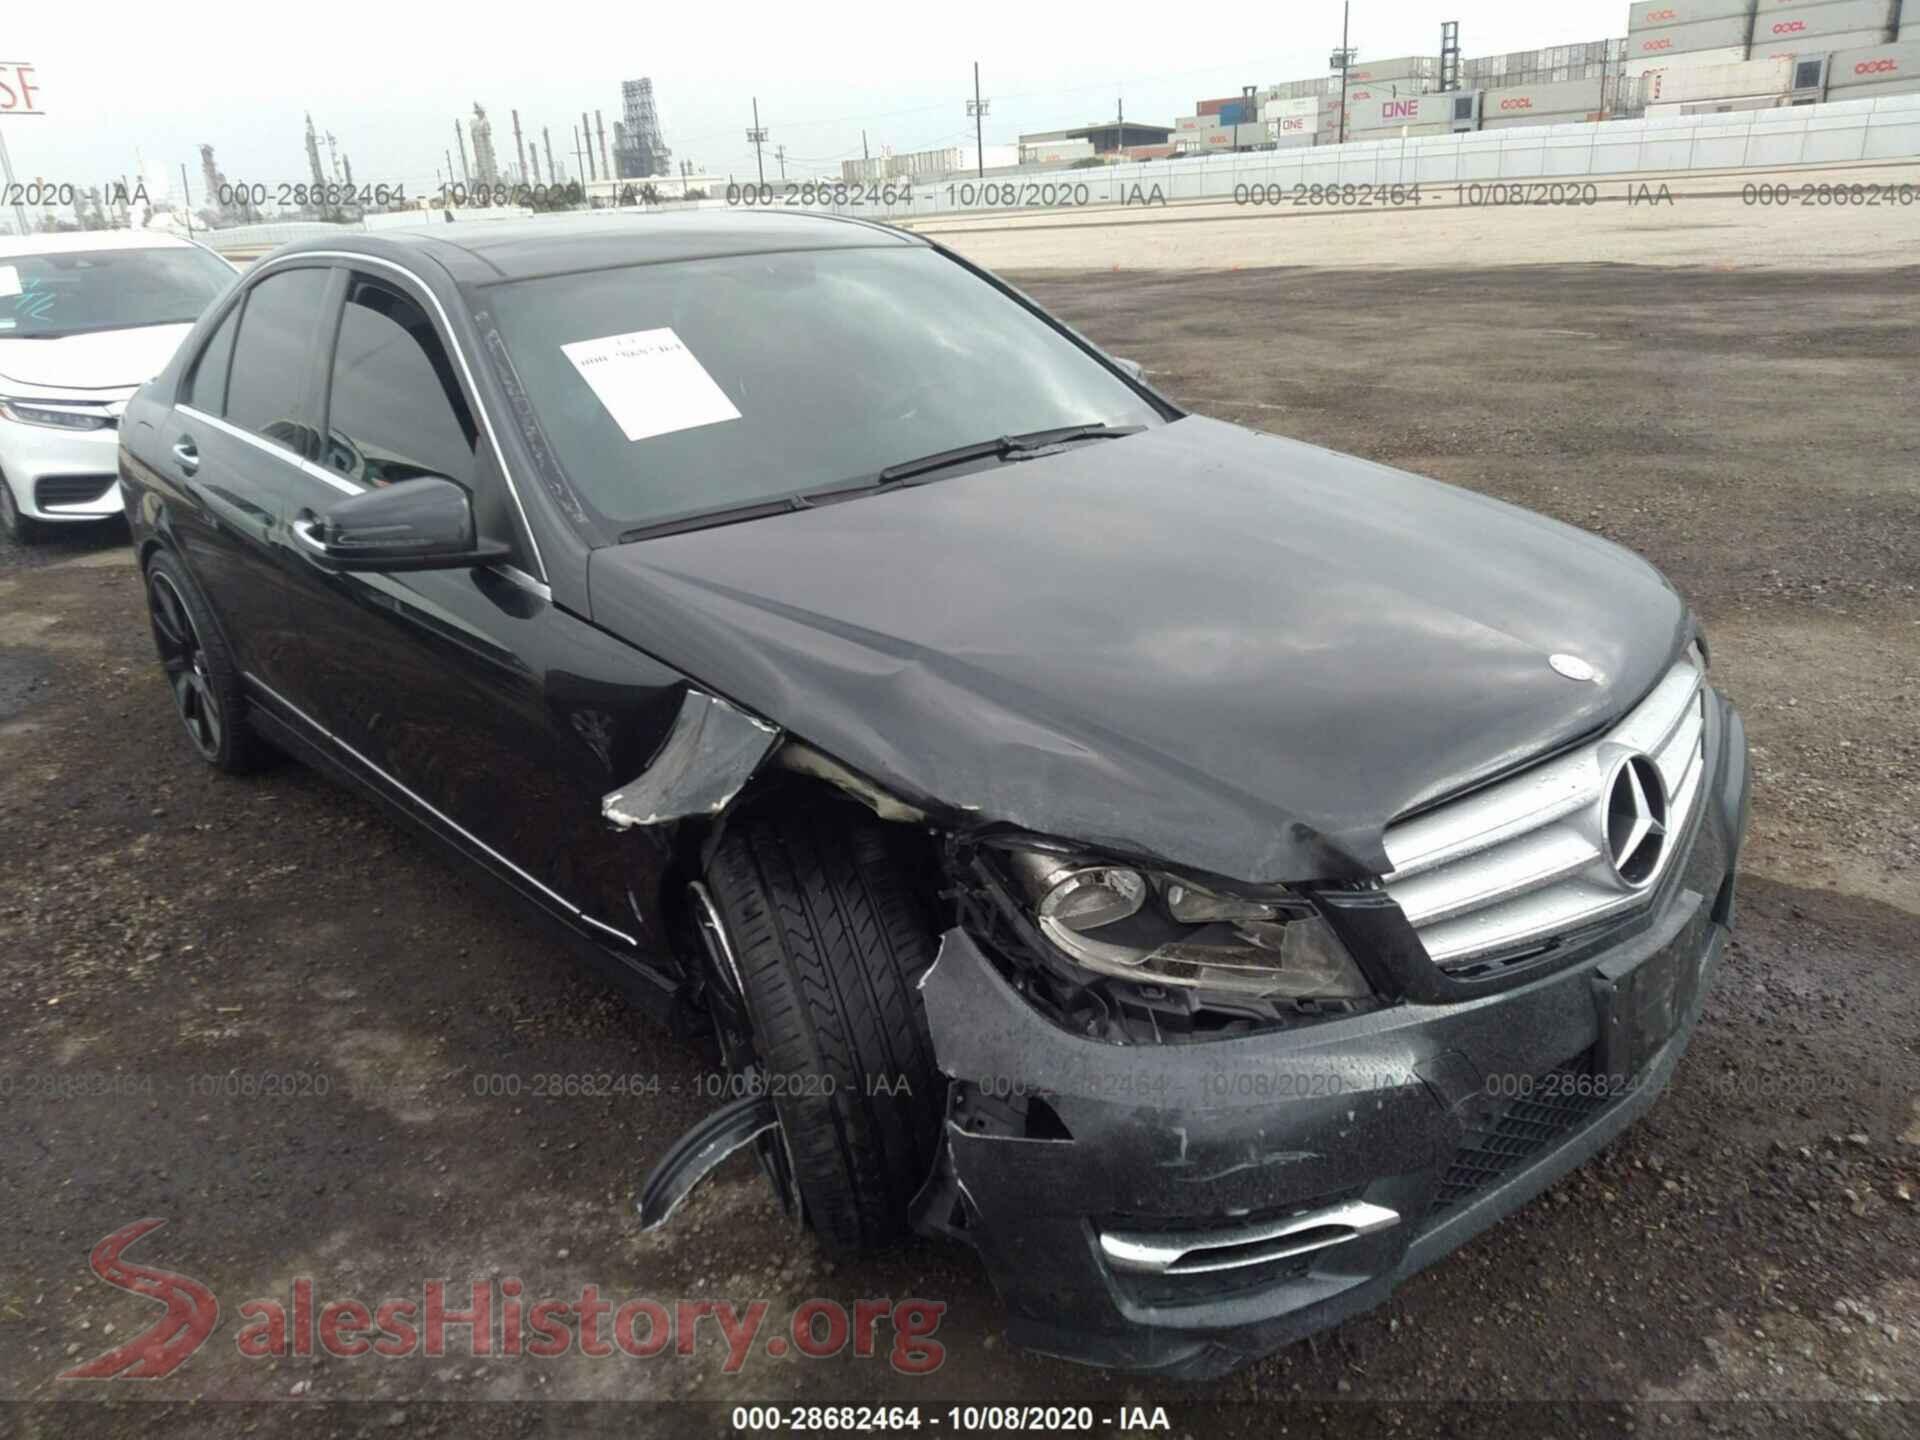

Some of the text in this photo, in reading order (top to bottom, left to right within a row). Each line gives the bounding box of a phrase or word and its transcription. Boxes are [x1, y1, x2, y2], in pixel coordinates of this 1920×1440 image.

[1773, 21, 1806, 34] OOCL
[1855, 59, 1897, 74] OOCL
[1382, 99, 1418, 117] ONE
[1501, 97, 1532, 109] OOCL
[1283, 119, 1304, 130] ONE
